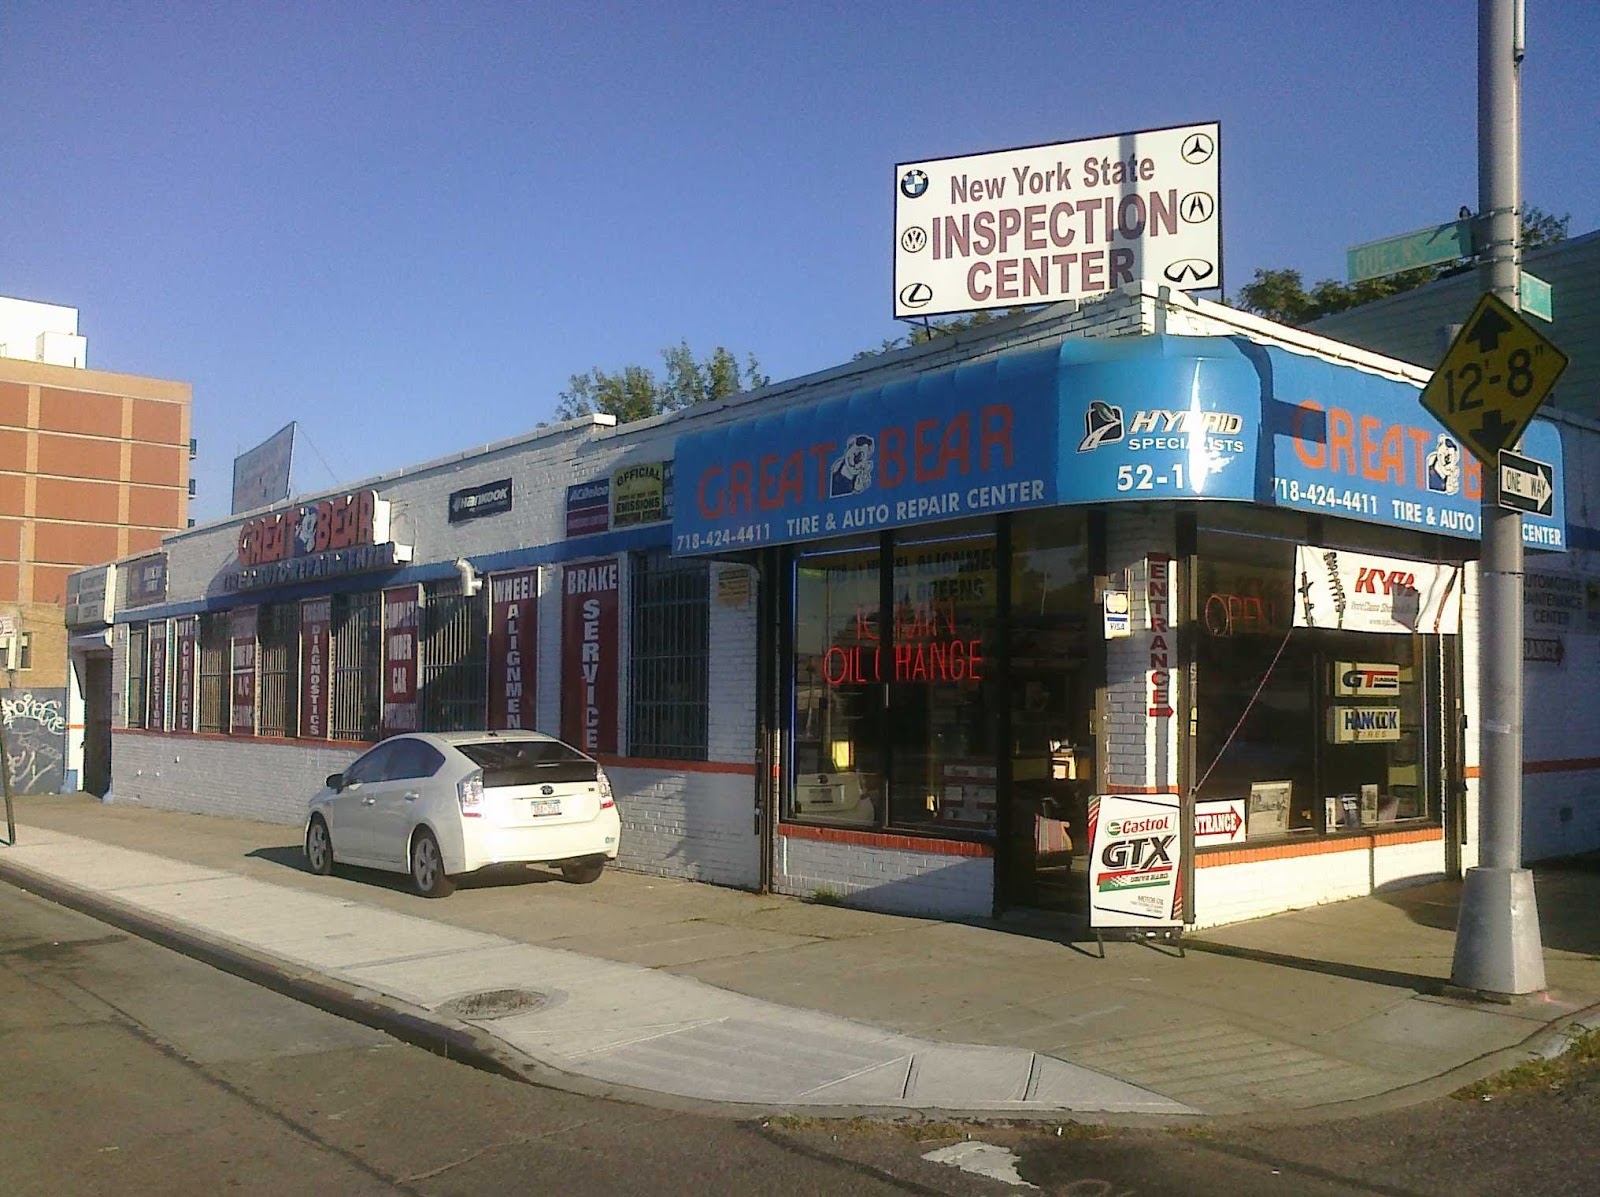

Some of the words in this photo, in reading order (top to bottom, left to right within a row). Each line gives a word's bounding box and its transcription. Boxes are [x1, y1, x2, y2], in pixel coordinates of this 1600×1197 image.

[951, 174, 1005, 205] New
[1013, 161, 1071, 195] York
[1083, 153, 1154, 188] State
[932, 189, 1177, 260] INSPECTION
[967, 248, 1135, 302] CENTER
[697, 440, 838, 520] GREAT
[879, 404, 1014, 489] BEAR
[1293, 400, 1431, 490] GREAT
[616, 466, 661, 487] OFFICIAL
[1506, 469, 1521, 492] ONE
[1531, 476, 1547, 499] WAY
[238, 510, 297, 566] GREAT
[315, 489, 374, 551] BEAR
[676, 522, 771, 551] 718-424-4411
[786, 514, 819, 538] TIRE
[824, 512, 836, 530] &
[842, 503, 890, 530] AUTO
[896, 492, 960, 521] REPAIR
[967, 479, 1045, 508] CENTER
[1392, 499, 1422, 524] TIRE
[1426, 506, 1436, 525] &
[1440, 508, 1474, 533] AUTO
[1521, 522, 1562, 546] CENTER
[493, 575, 536, 604] WHEEL
[567, 564, 617, 595] BRAKE
[1150, 563, 1170, 705] ENTRANCE
[181, 641, 190, 729] CHANGE
[310, 624, 321, 736] DIAGNOSTICS
[506, 603, 522, 729] ALIGNMEN
[582, 599, 600, 749] SERVICE
[822, 646, 867, 685] OIL
[1122, 816, 1169, 834] Castrol
[1195, 813, 1237, 834] NTRANCE
[1102, 834, 1177, 871] GTX
